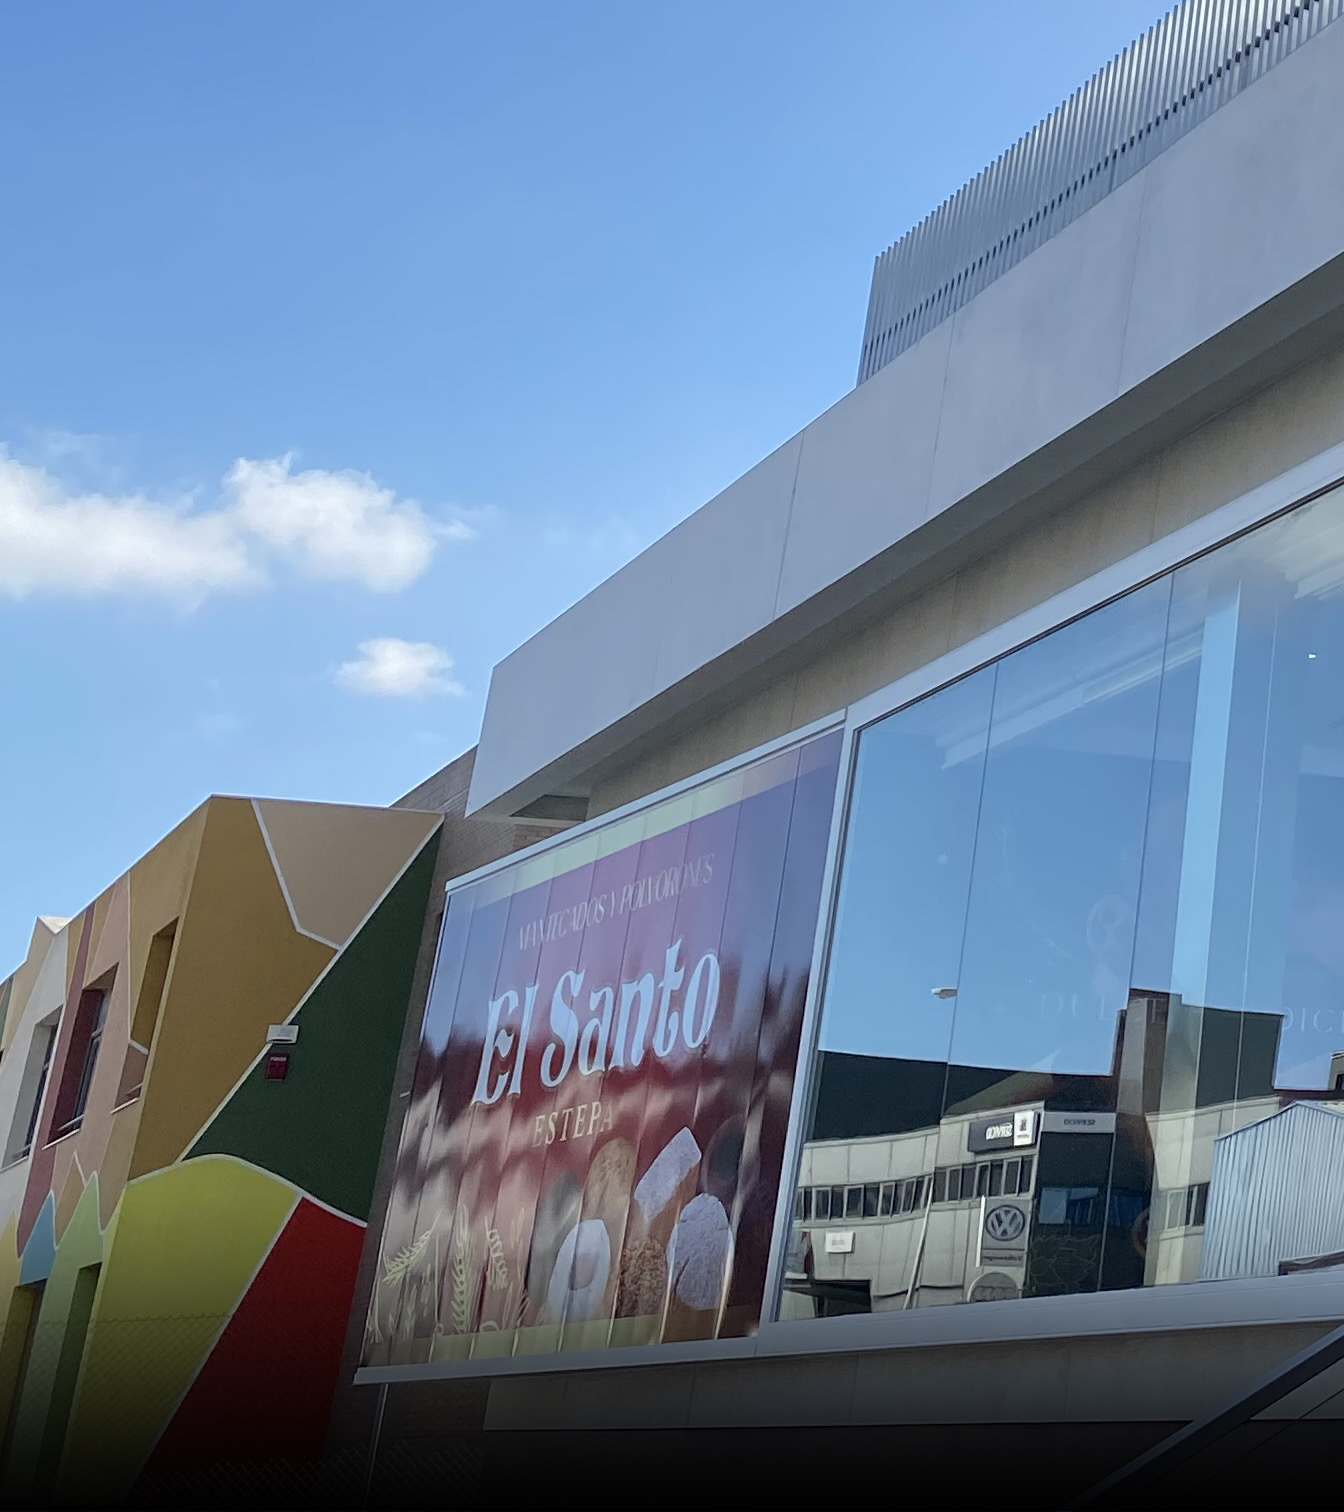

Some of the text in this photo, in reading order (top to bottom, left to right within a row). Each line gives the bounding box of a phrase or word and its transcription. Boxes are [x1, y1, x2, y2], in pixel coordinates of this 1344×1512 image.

[471, 938, 721, 1106] El Santo
[532, 1101, 614, 1147] ESTEPA
